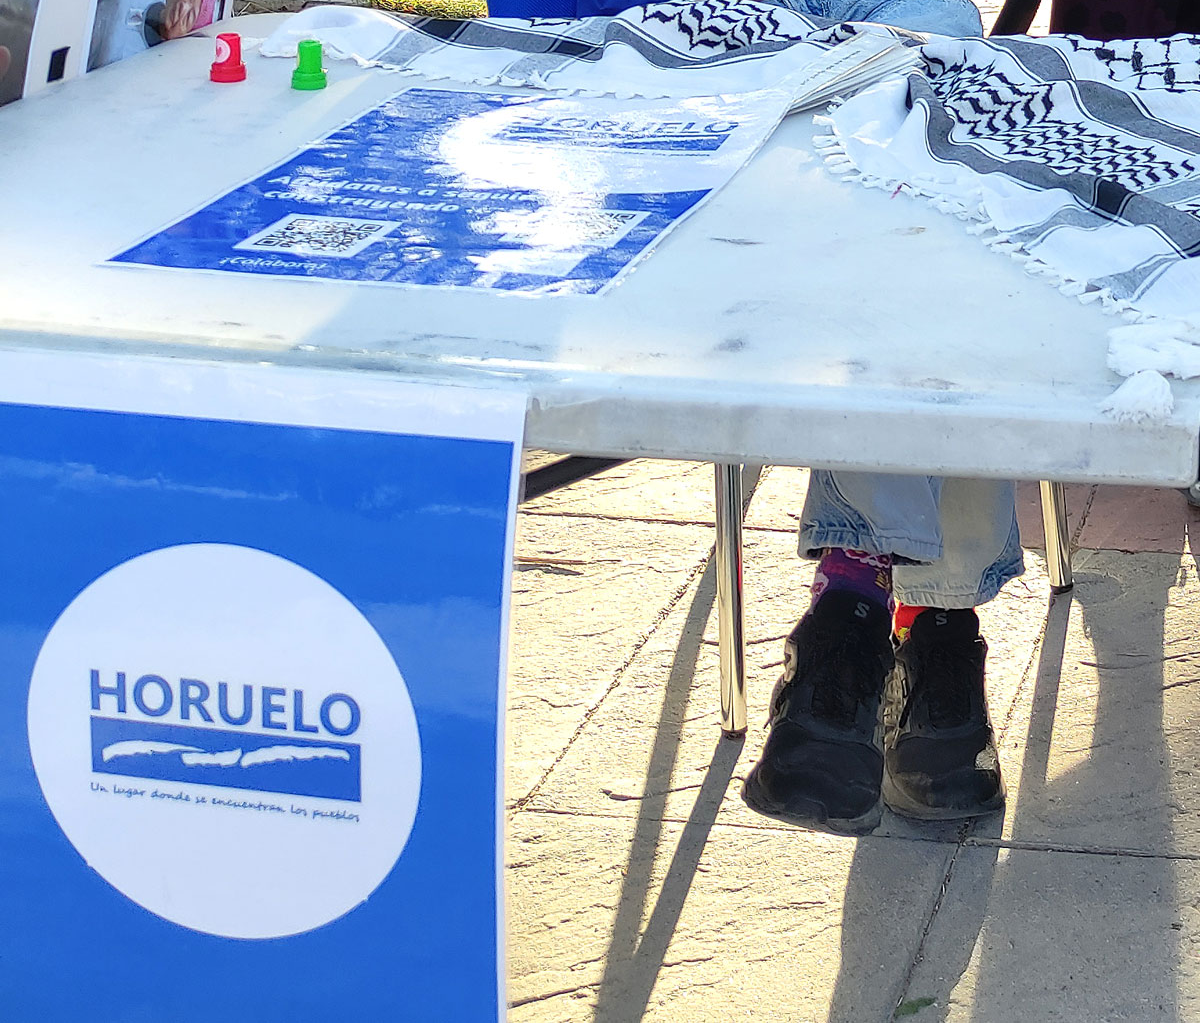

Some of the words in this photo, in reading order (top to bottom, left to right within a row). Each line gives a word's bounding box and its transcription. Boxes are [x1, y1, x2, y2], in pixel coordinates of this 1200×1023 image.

[263, 190, 460, 212] construyendo
[417, 188, 437, 197] a
[90, 669, 361, 737] HORUELO
[90, 782, 109, 793] Un
[113, 785, 146, 798] lugar
[151, 789, 191, 802] donde
[195, 795, 208, 804] se
[211, 796, 286, 813] encuentran
[290, 804, 308, 816] los
[312, 809, 361, 823] pueblos
